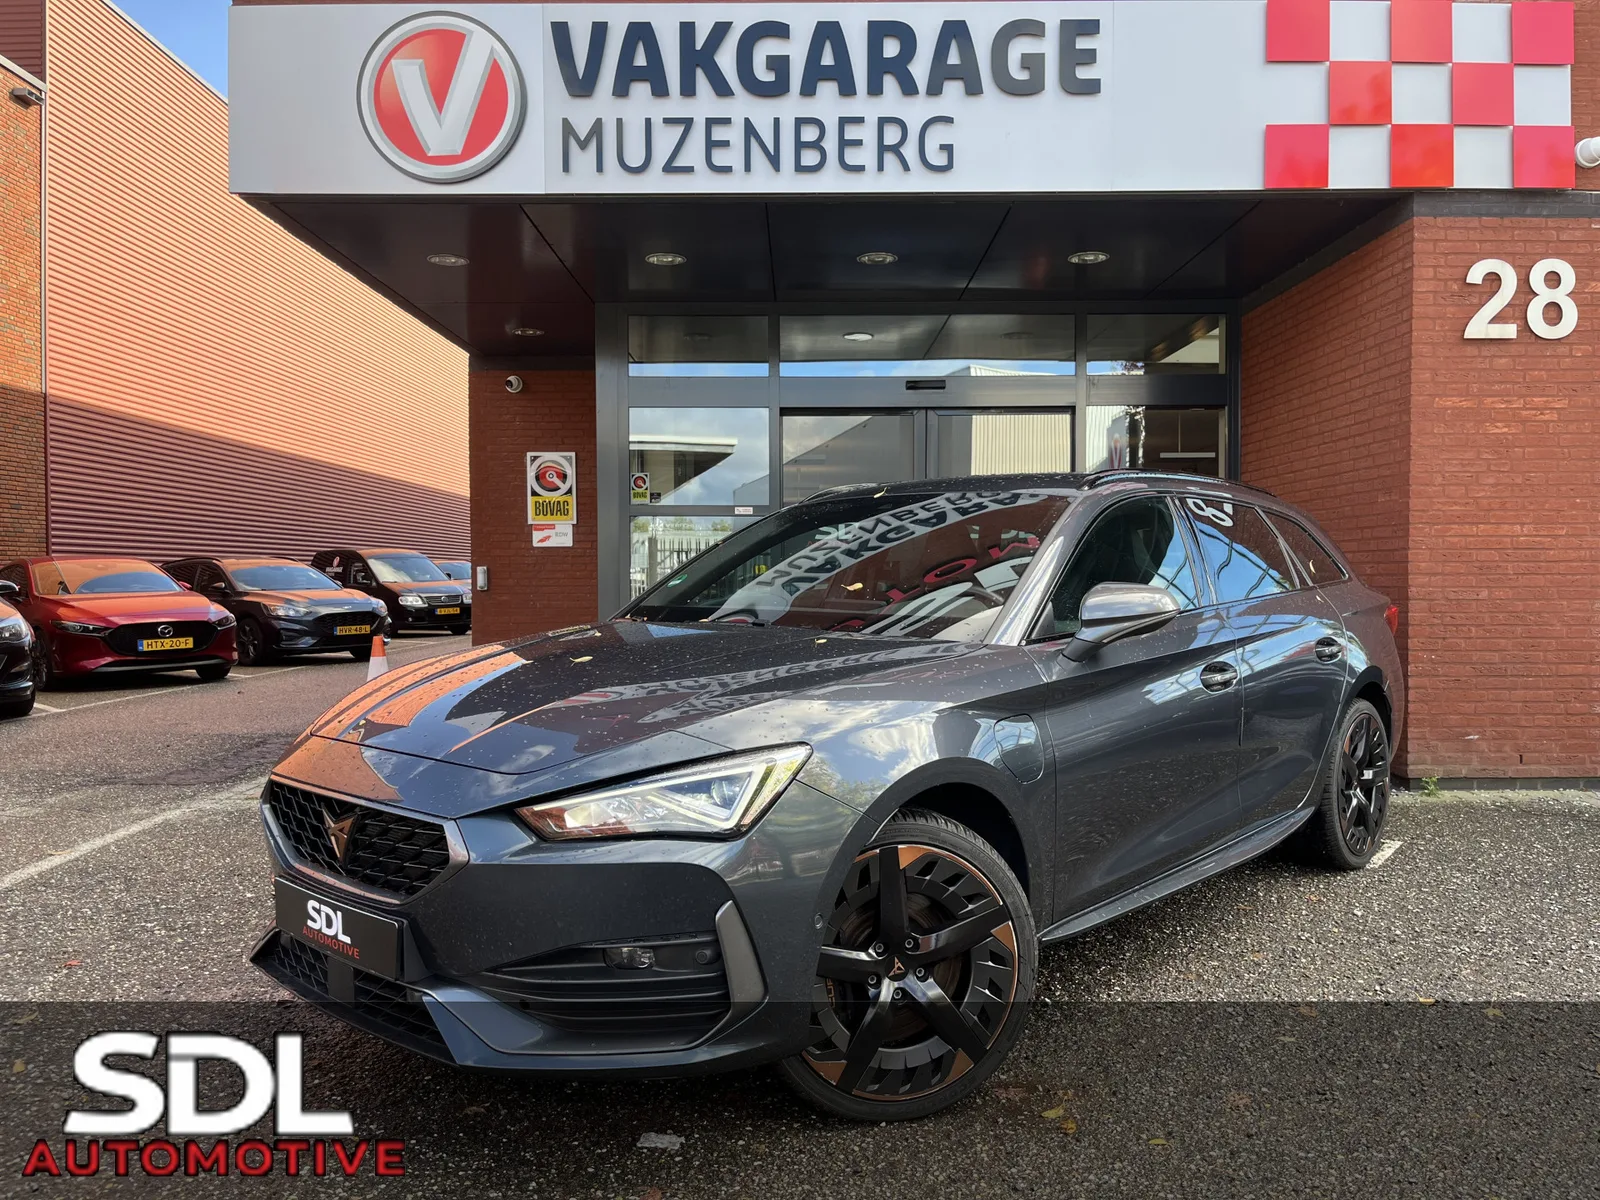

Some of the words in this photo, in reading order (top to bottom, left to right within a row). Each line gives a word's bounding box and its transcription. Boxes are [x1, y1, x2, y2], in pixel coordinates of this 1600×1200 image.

[550, 19, 1101, 98] VAKGARAGE
[562, 116, 955, 174] MUZENBERG
[1464, 259, 1579, 340] 28
[534, 500, 570, 517] BOVAG
[146, 638, 190, 649] HTX-20-F
[338, 626, 369, 635] HVR-48-L
[307, 900, 352, 945] SDL
[302, 926, 360, 959] AUTOMOTIVE
